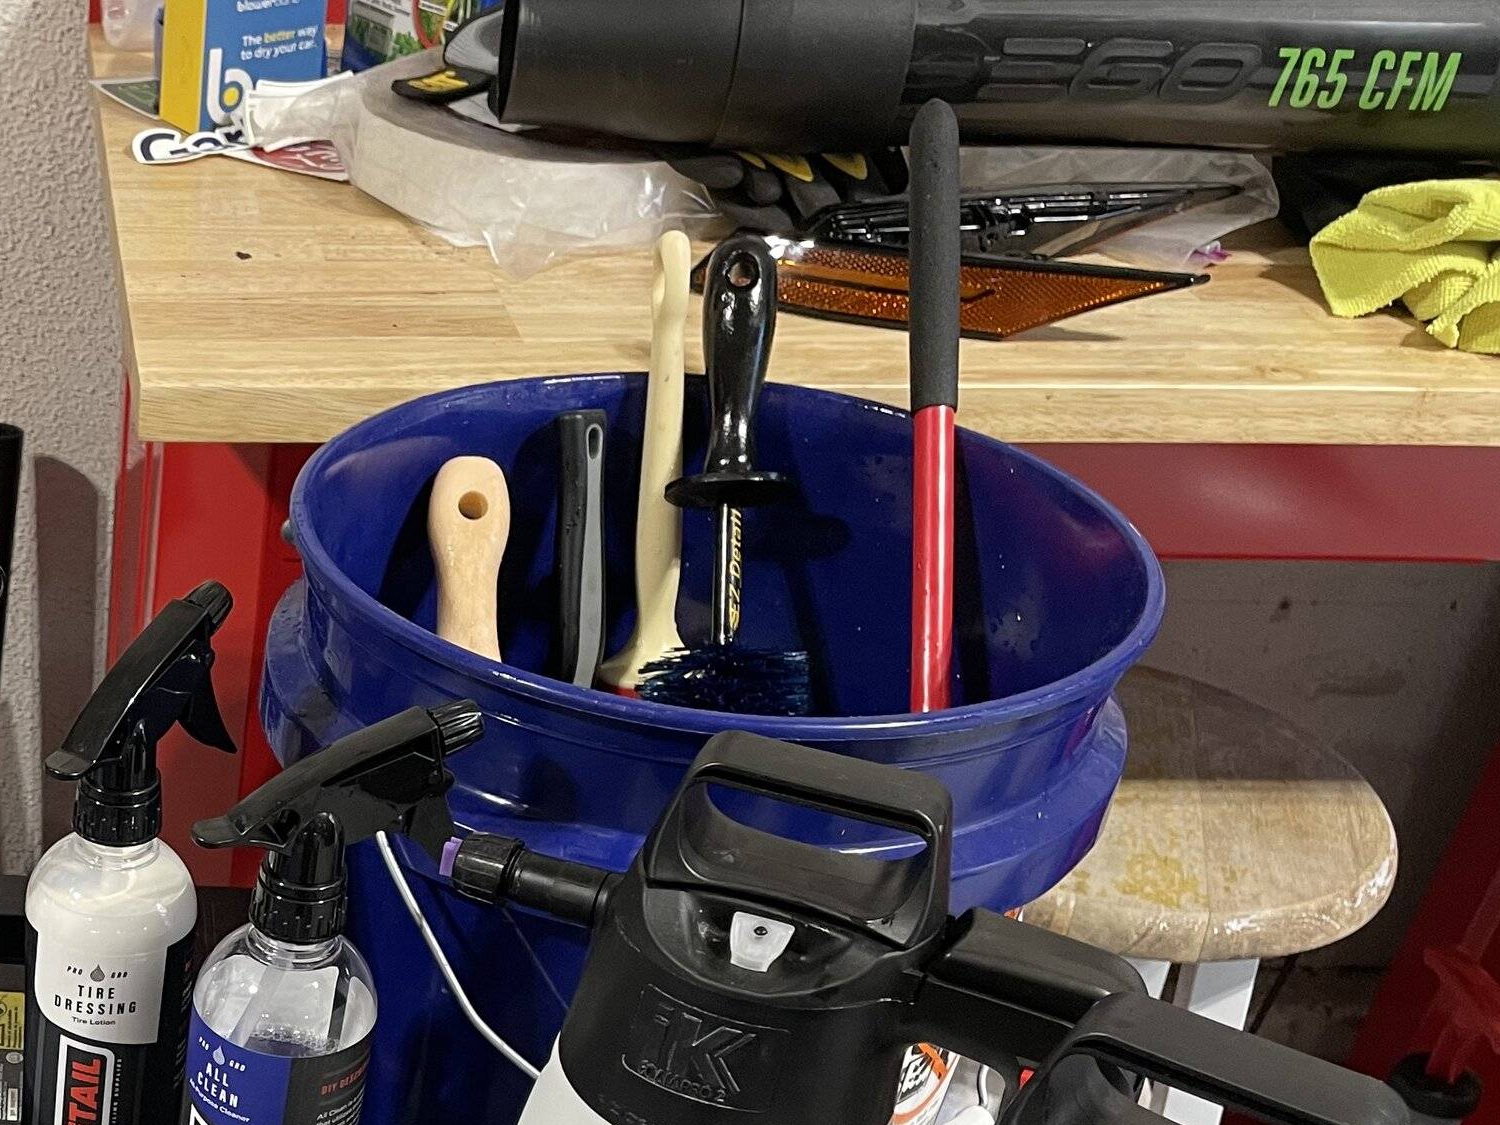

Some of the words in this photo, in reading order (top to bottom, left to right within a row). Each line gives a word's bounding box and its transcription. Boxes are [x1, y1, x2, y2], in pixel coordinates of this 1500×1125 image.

[242, 35, 262, 47] The
[264, 31, 296, 43] better
[241, 50, 253, 60] to
[254, 47, 272, 60] dry
[273, 43, 297, 58] your
[1268, 47, 1354, 109] 765
[1358, 49, 1462, 112] CFM
[728, 507, 742, 579] Detail
[77, 984, 115, 999] TIRE
[54, 994, 136, 1015] DRESSING
[72, 1016, 87, 1024] Tire
[206, 1062, 228, 1087] ALL
[197, 1071, 238, 1108] CLEAN
